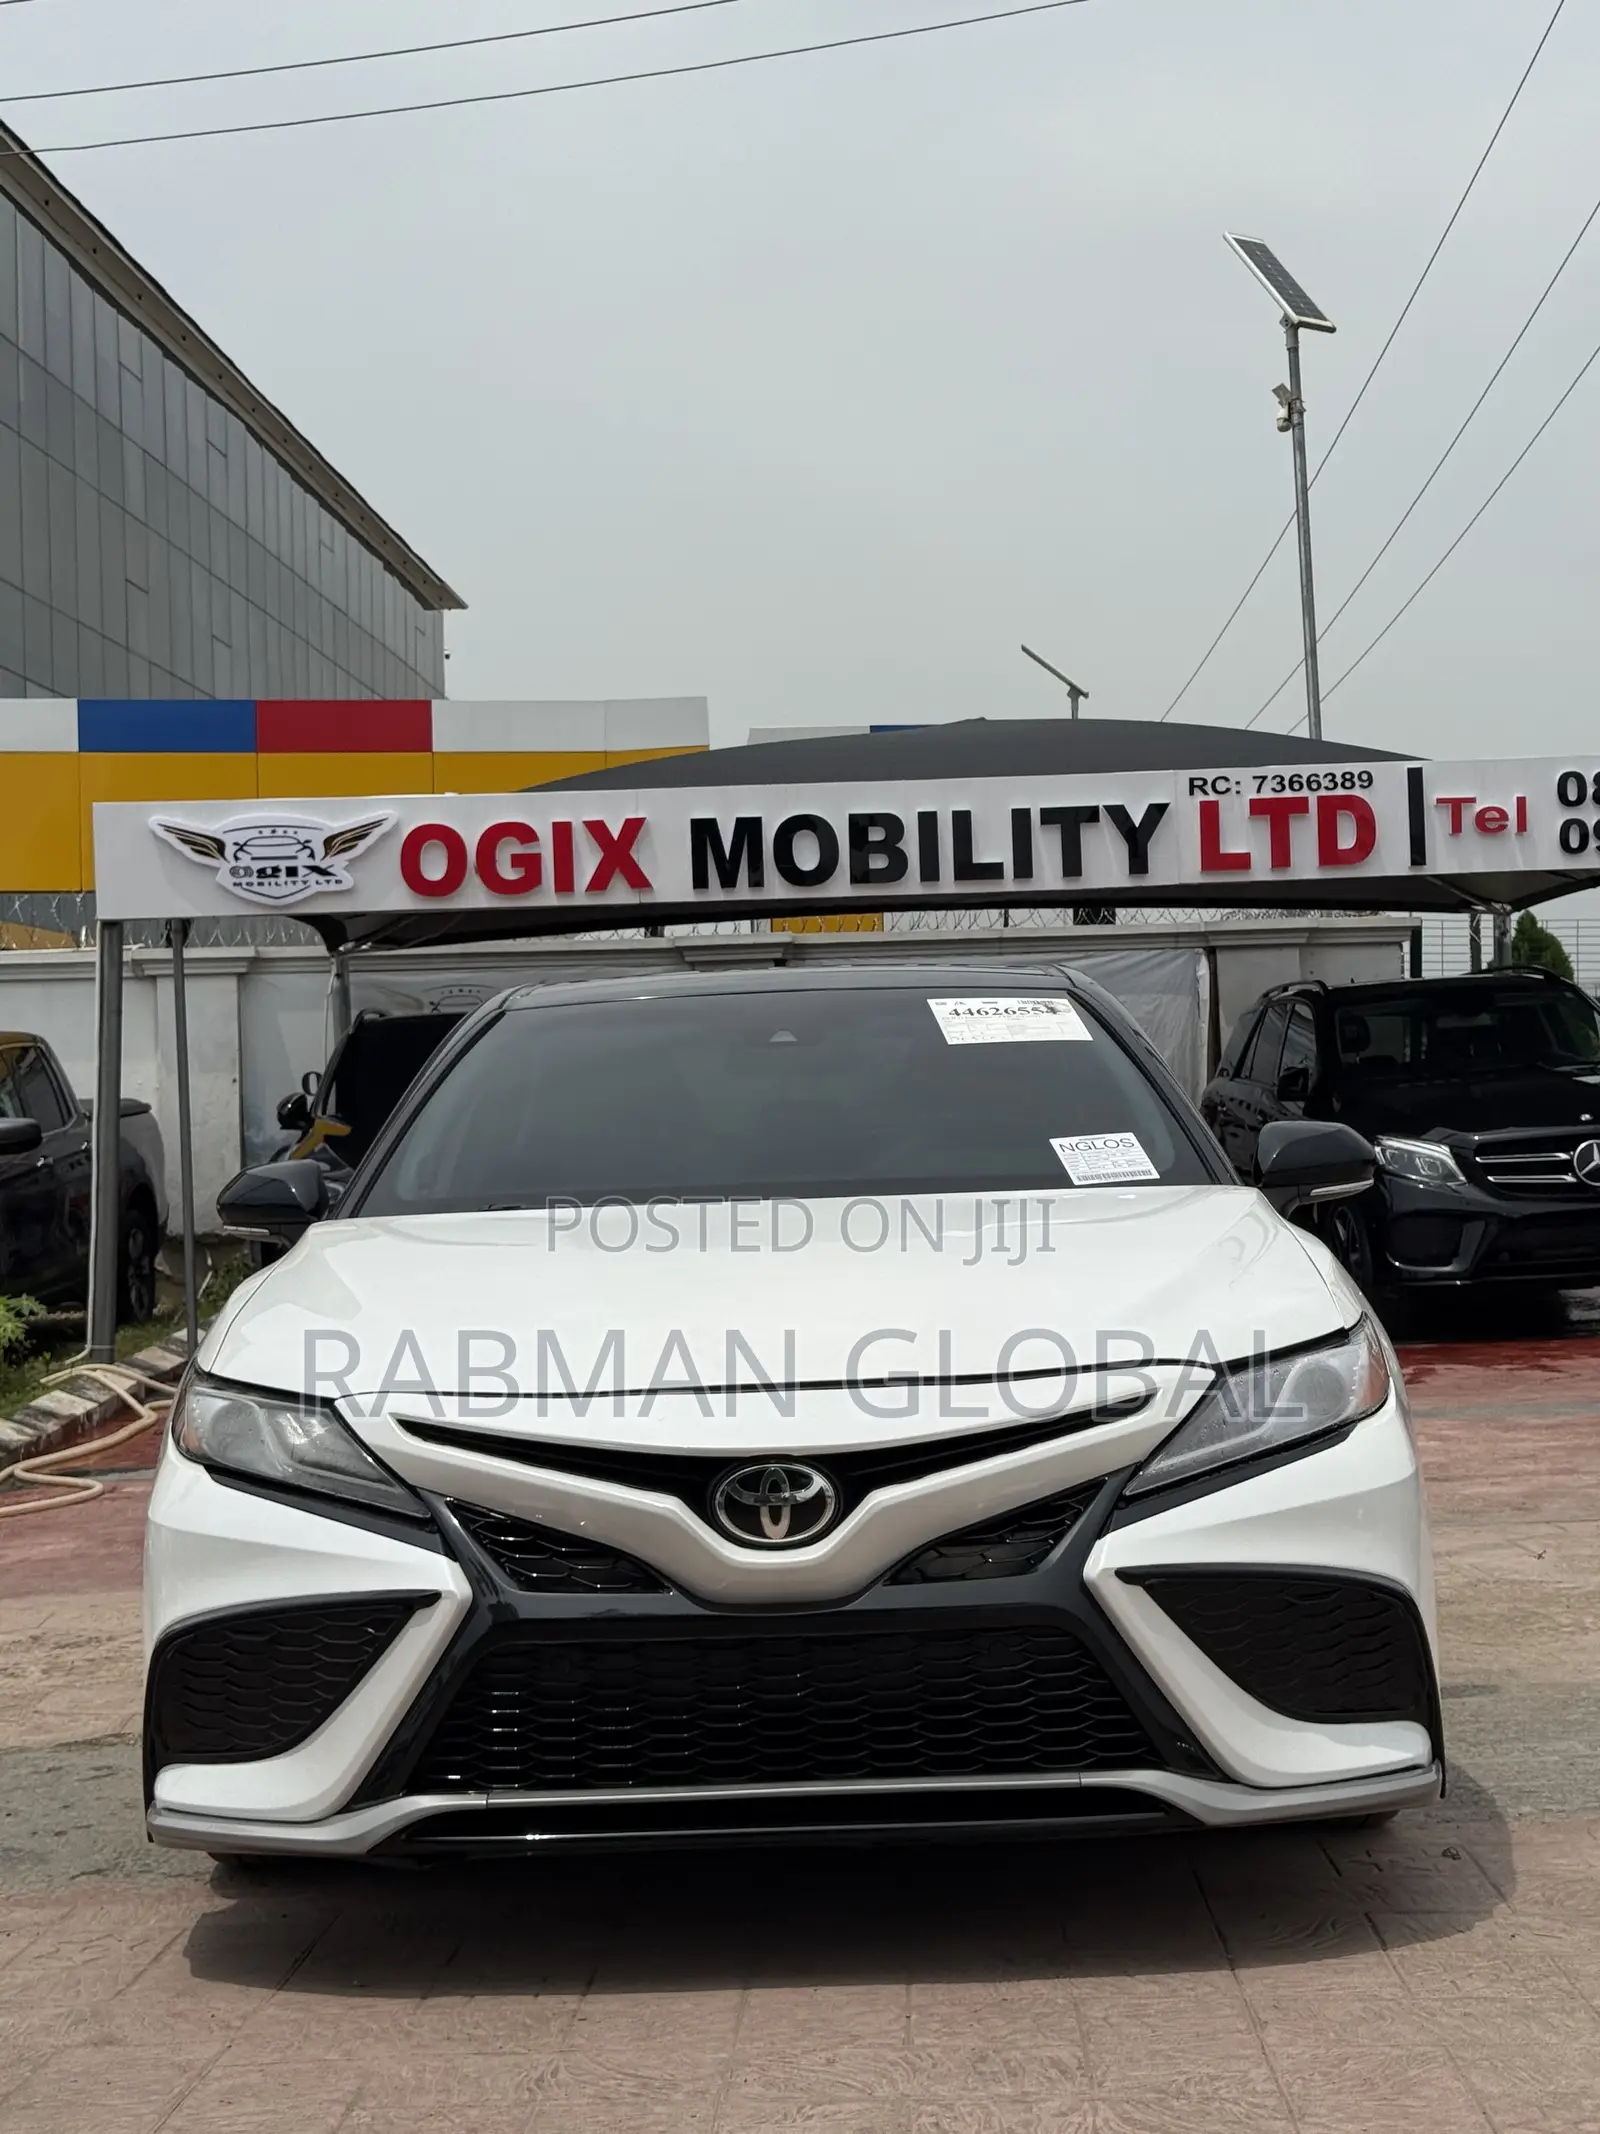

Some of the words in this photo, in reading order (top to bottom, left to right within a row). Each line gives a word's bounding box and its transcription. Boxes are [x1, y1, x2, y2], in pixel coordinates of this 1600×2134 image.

[1189, 775, 1242, 796] RC:
[1252, 770, 1374, 794] 7366389
[1557, 770, 1600, 807] 0
[1436, 795, 1527, 835] Tel
[400, 817, 654, 898] OGIX
[690, 802, 1171, 890] MOBILITY
[1199, 793, 1377, 872] LTD
[1559, 818, 1600, 855] 0
[1058, 1137, 1135, 1153] NGLOS
